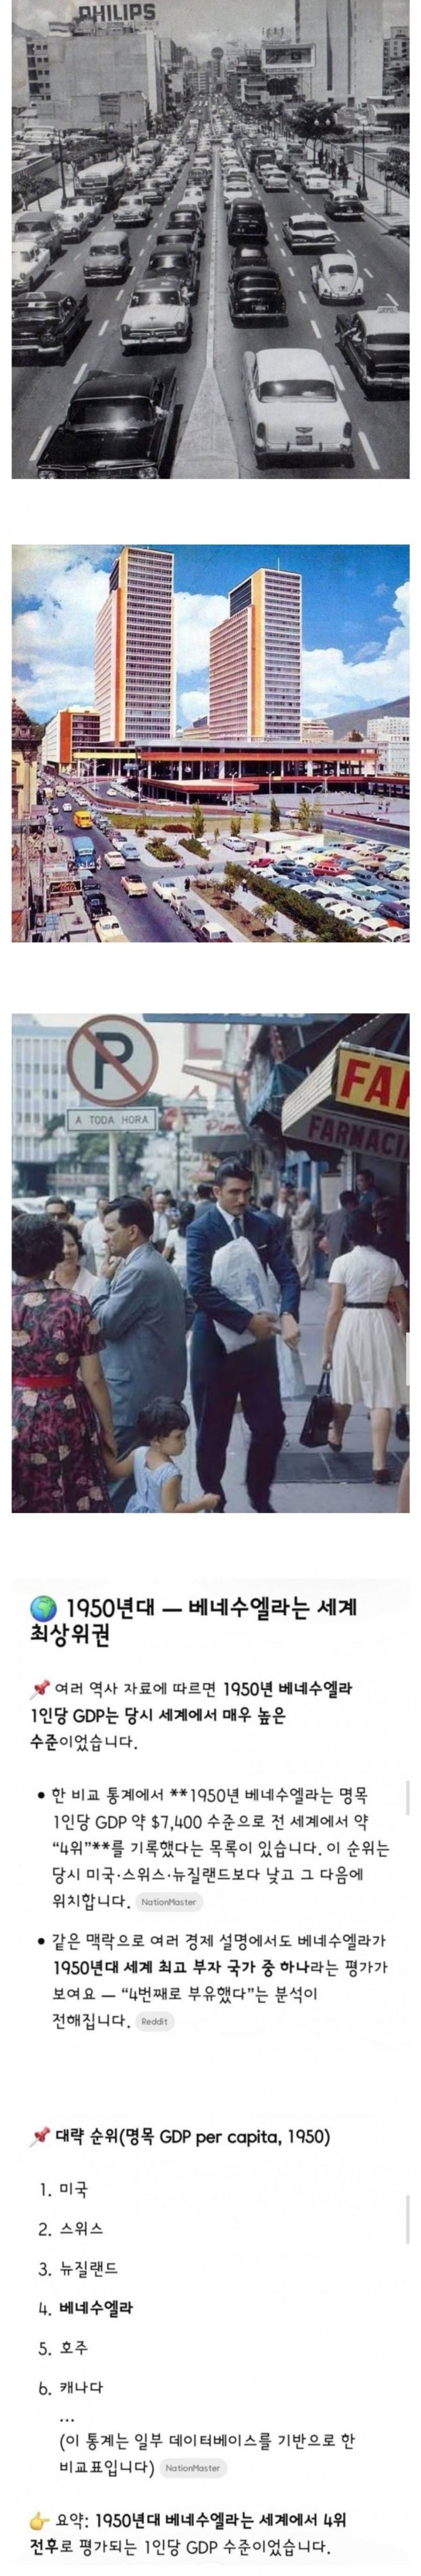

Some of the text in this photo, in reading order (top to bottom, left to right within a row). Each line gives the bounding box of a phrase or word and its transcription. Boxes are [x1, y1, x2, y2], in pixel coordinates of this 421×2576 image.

[79, 3, 156, 22] PHILIPS
[75, 1115, 149, 1124] A TODA HORA
[67, 1597, 154, 1620] 1950년대
[189, 1596, 310, 1621] 베네수엘라는
[317, 1598, 357, 1616] 세계
[30, 1623, 109, 1648] 최상위권
[55, 1680, 353, 1699] 여러 역사 자료에 따르면 1950년 베네수엘라
[31, 1707, 286, 1725] 1인당 GDP는 당시 세계에서 매우 높은
[30, 1734, 138, 1752] 수준이었습니다.
[51, 1787, 66, 1804] 한
[72, 1788, 100, 1802] 비교
[106, 1787, 163, 1805] 통계에서
[245, 1787, 334, 1805] 베네수엘라는
[340, 1787, 368, 1805] 명목
[54, 1814, 369, 1832] 1인당 GDP 약 $7,400 수준으로 전 세계에서 약
[131, 1840, 203, 1858] 기록했다는
[209, 1840, 252, 1858] 목록이
[258, 1840, 322, 1858] 있습니다.
[327, 1841, 340, 1854] 이
[347, 1840, 390, 1858] 순위는
[52, 1867, 80, 1885] 당시
[267, 1867, 295, 1885] 낮고
[300, 1869, 314, 1880] 그
[320, 1866, 363, 1885] 다음에
[52, 1893, 131, 1911] 위치합니다.
[52, 1932, 386, 1951] 같은 맥락으로 여러 경제 설명에서도 베네수엘라가
[54, 1959, 388, 1978] 1950년대 세계 최고 부자 국가 중 하나라는 평가가
[52, 1987, 96, 2000] 보여요
[275, 1986, 317, 2004] 분석이
[52, 2012, 131, 2031] 전해집니다.
[56, 2127, 330, 2148] 대략 순위(명목 GDP per capita, 1950)
[40, 2181, 88, 2199] 1. 미국
[38, 2221, 103, 2237] 2. 스위스
[38, 2260, 118, 2279] 3. 뉴질랜드
[39, 2300, 134, 2318] 4. 베네수엘라
[38, 2340, 88, 2356] 5. 호주
[38, 2381, 104, 2396] 6. 캐나다
[59, 2432, 356, 2452] (이 통계는 일부 데이터베이스를 기반으로 한
[60, 2459, 154, 2479] 비교표입니다)
[56, 2511, 346, 2530] 요약: 1950년대 베네수엘라는 세계에서 4위
[30, 2538, 331, 2557] 전후로 평가되는 1인당 GDP 수준이었습니다.
